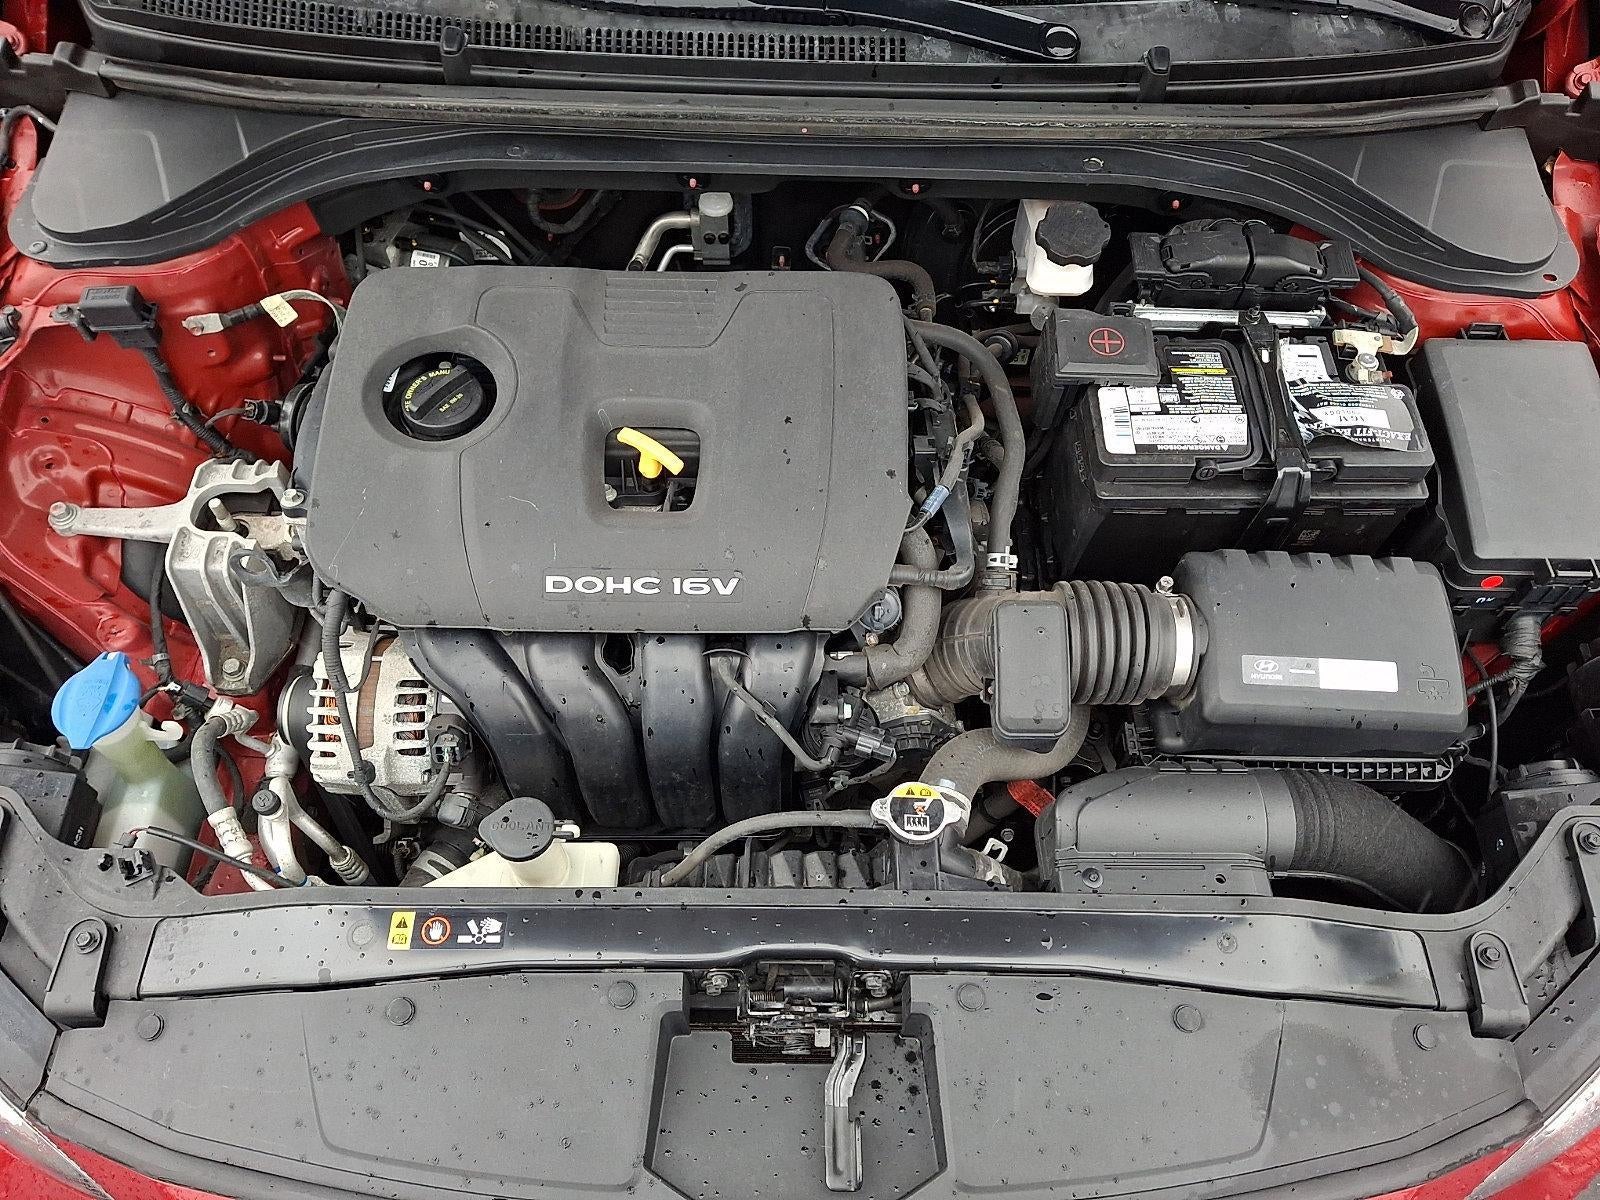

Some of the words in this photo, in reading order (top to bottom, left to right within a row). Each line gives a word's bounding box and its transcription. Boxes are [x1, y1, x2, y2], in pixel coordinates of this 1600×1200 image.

[405, 376, 428, 399] OWNER'S
[428, 369, 451, 378] MANU
[1353, 427, 1411, 441] EXACT-FIT
[545, 575, 661, 595] DOHC
[672, 577, 740, 595] 16V
[1251, 673, 1283, 681] HYUNDAI
[492, 821, 554, 831] COOLANT
